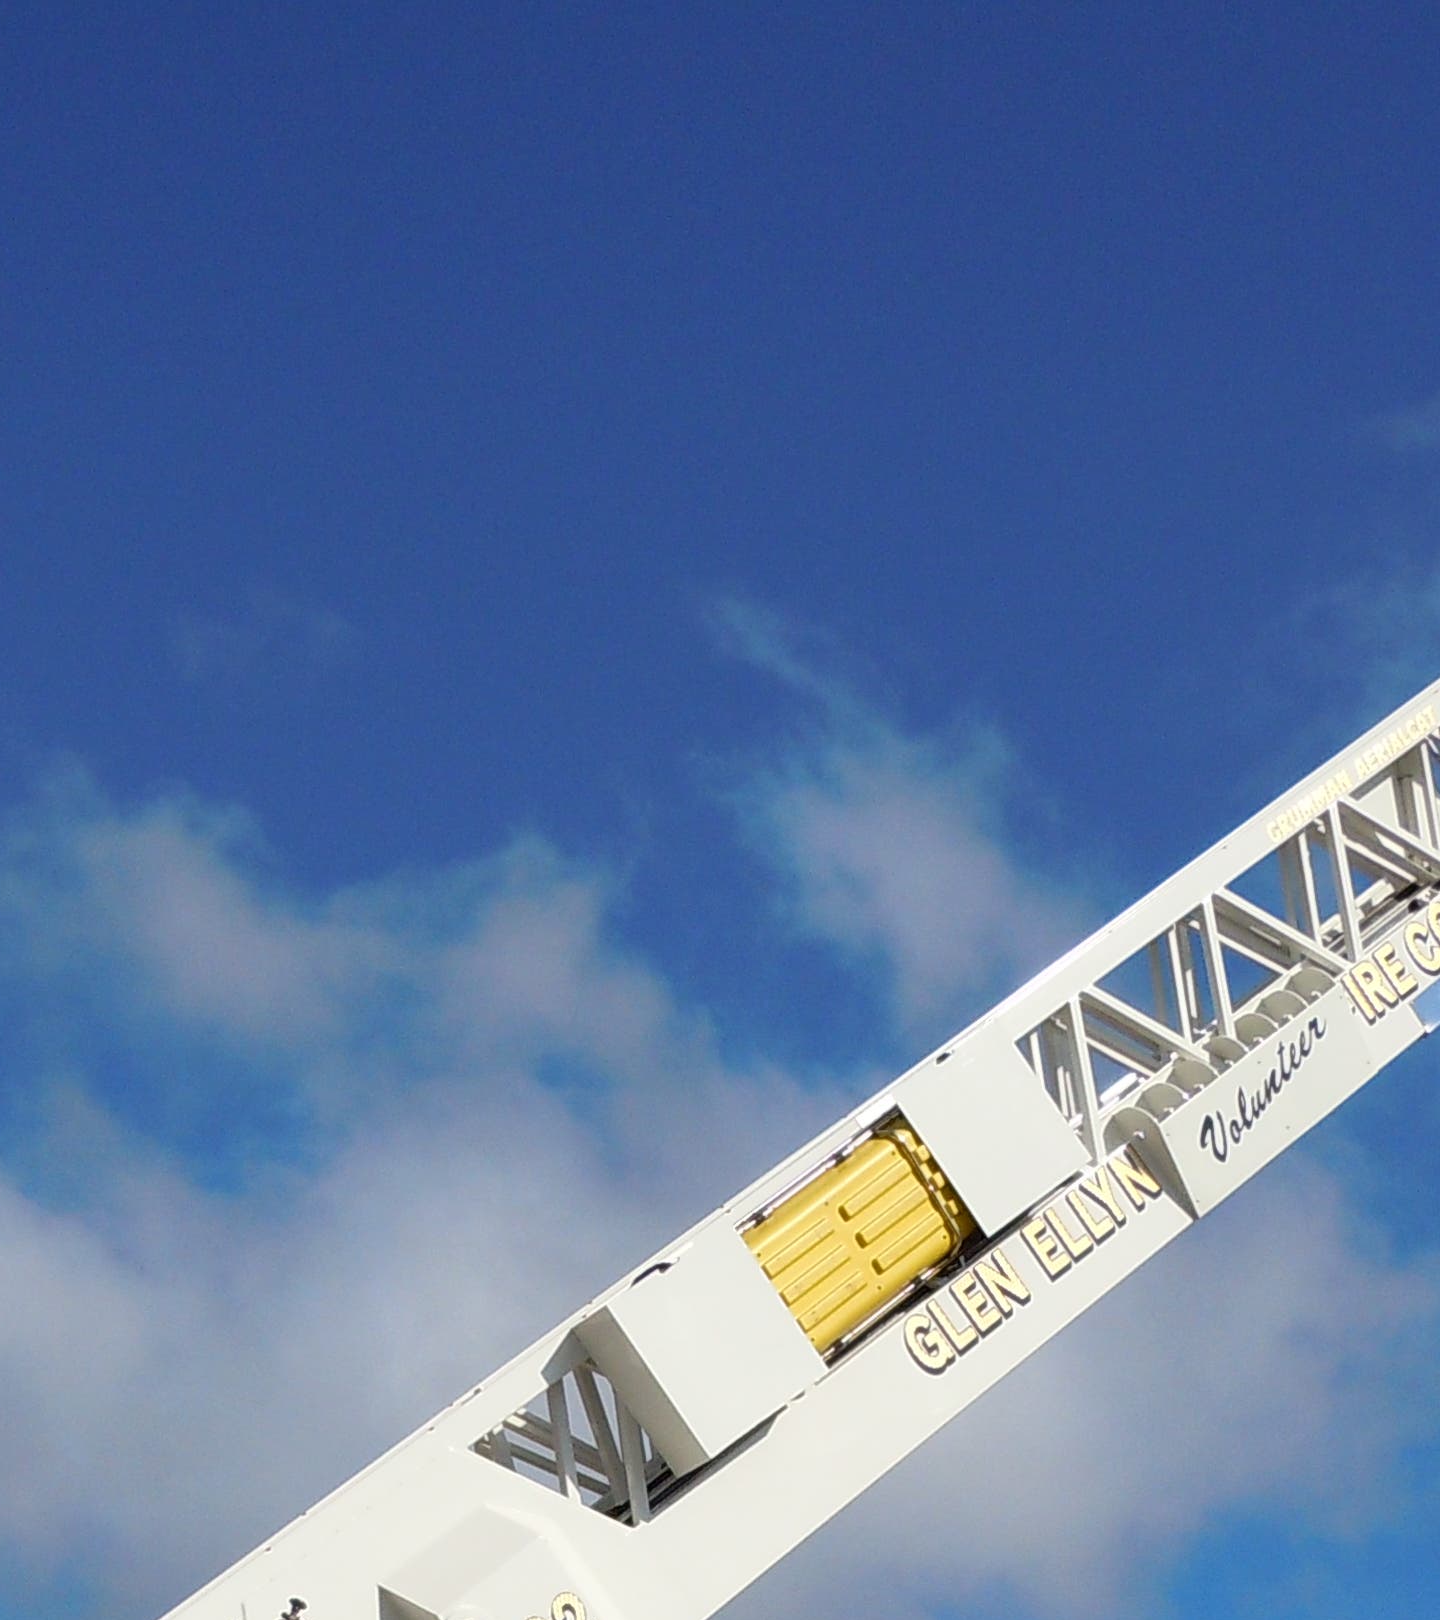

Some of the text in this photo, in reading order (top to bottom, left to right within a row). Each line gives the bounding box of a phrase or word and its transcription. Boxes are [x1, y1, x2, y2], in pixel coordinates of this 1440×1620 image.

[1266, 768, 1354, 844] GRUMMAN
[903, 1248, 1032, 1376] GLEN
[1020, 1142, 1163, 1283] ELLYN
[1199, 1015, 1327, 1164] Volunteer
[1340, 942, 1419, 1026] IRE
